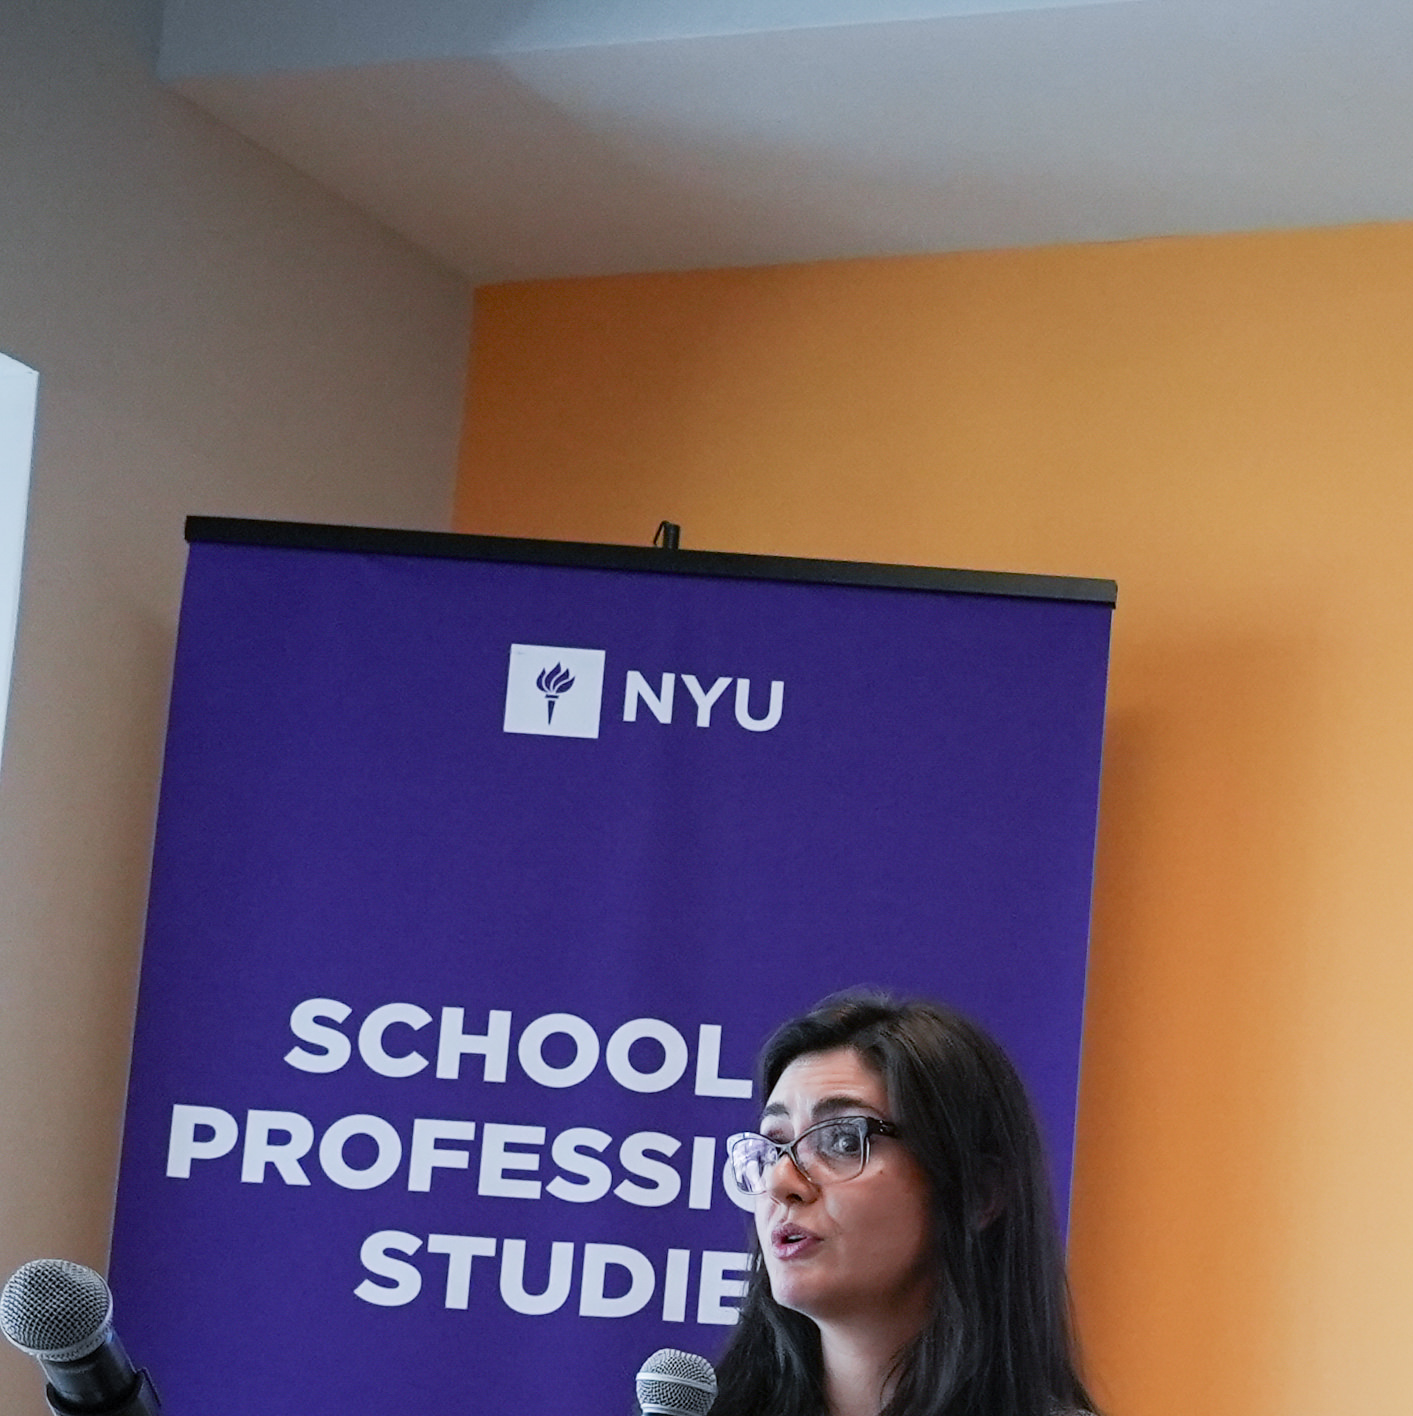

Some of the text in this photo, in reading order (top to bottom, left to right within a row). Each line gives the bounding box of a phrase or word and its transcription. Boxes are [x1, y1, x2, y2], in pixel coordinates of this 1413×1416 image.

[622, 670, 784, 732] NYU
[282, 996, 754, 1099] SCHOOL
[353, 1229, 754, 1326] STUDIE
